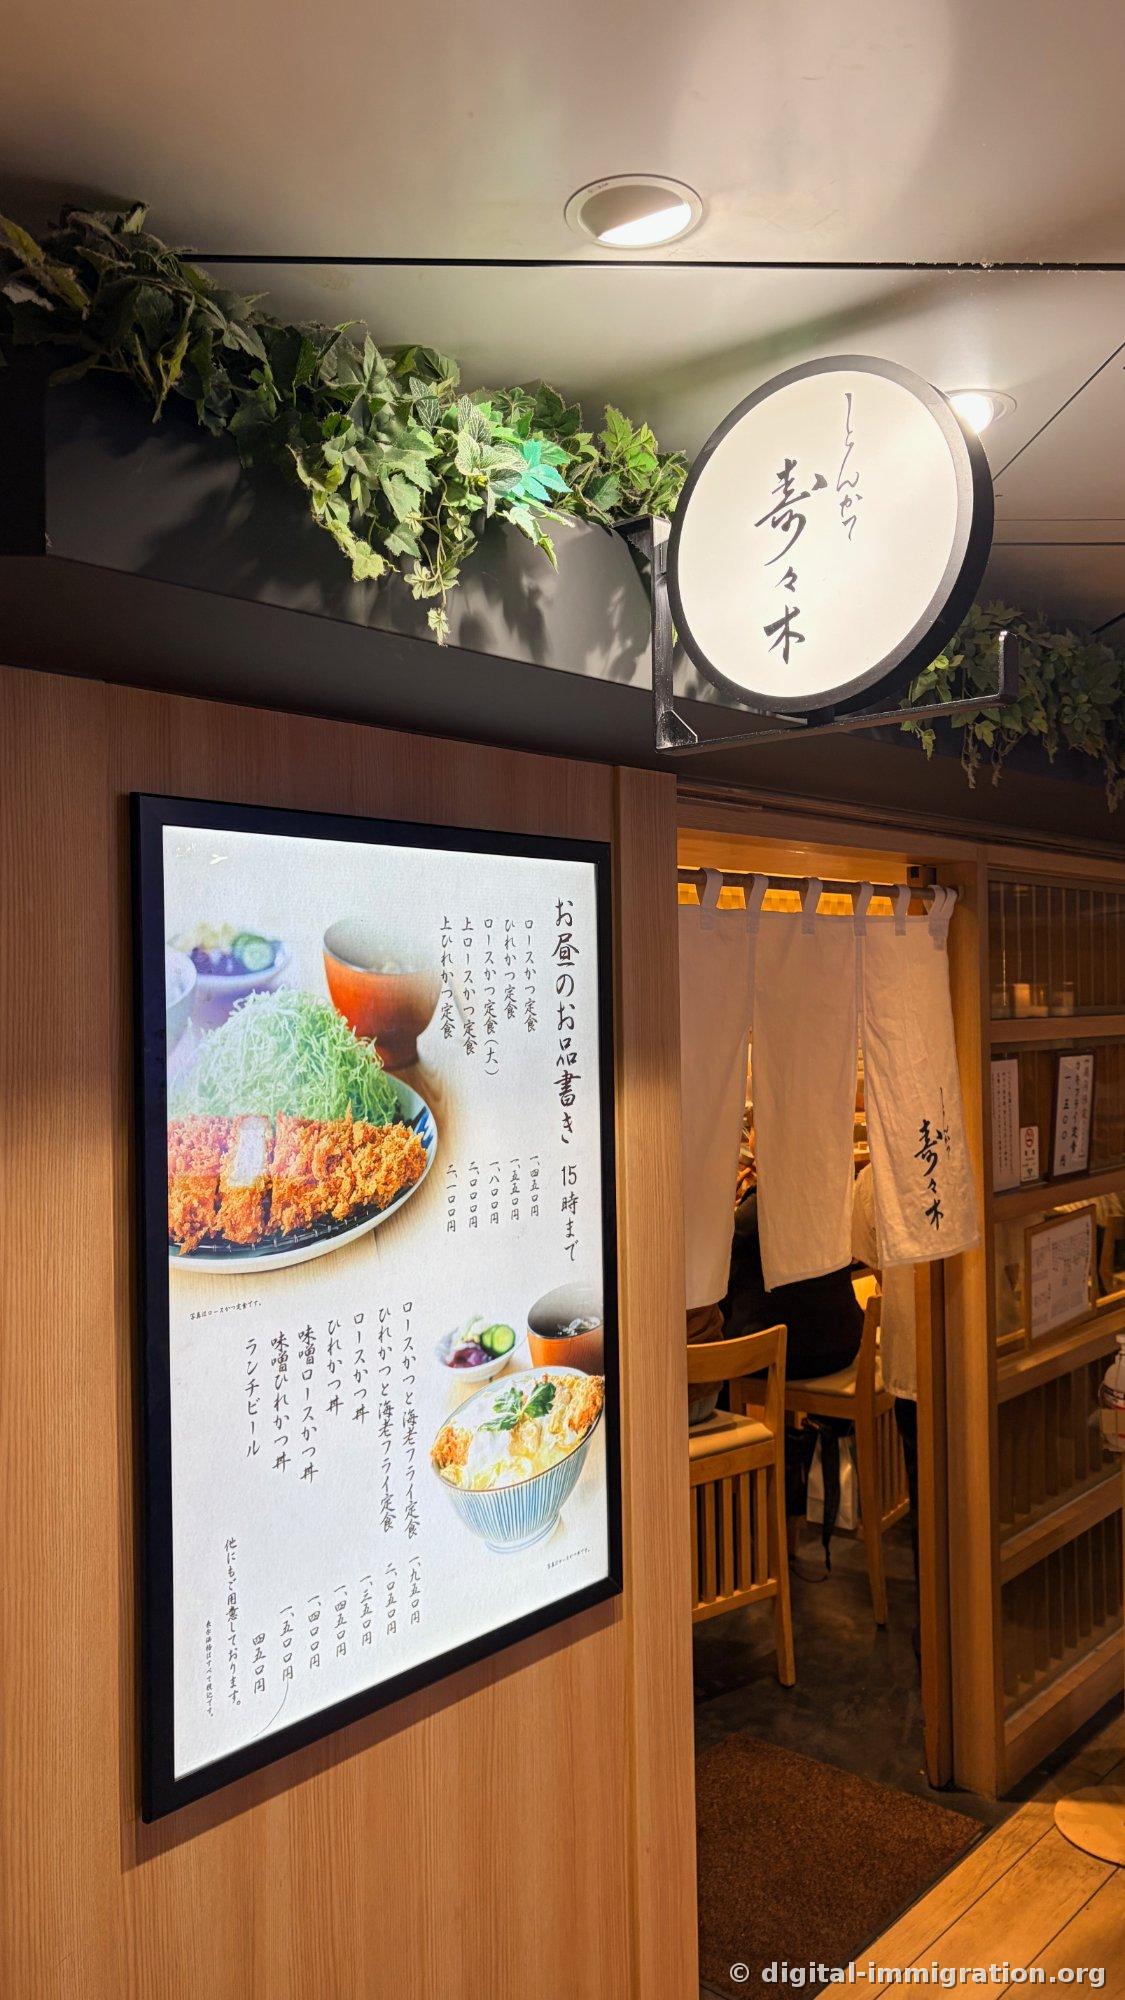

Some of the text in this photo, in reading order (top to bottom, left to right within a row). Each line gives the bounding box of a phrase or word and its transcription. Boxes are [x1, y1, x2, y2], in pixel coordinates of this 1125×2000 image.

[754, 458, 827, 664] 寿々木
[440, 915, 454, 1040] 上ひれかつ定食
[461, 916, 477, 1056] 上ロースかつ定食
[503, 917, 518, 1020] ひれかつ定食
[523, 918, 538, 1033] ロースかつ定食
[551, 898, 581, 1261] お昼のお品書き 15時まで
[245, 1339, 260, 1457] ランチビール
[271, 1331, 291, 1472] 味噌ひれかつ丼
[298, 1325, 318, 1483] 味噌ロースかつ丼
[326, 1320, 344, 1415] ひれかつ丼
[352, 1313, 369, 1424] ロースかつ丼
[378, 1308, 396, 1532] ひれかつと海老フライ定食
[402, 1302, 420, 1539] ロースかつと海老フライ定食
[225, 1537, 241, 1705] 他にもご用意しております。
